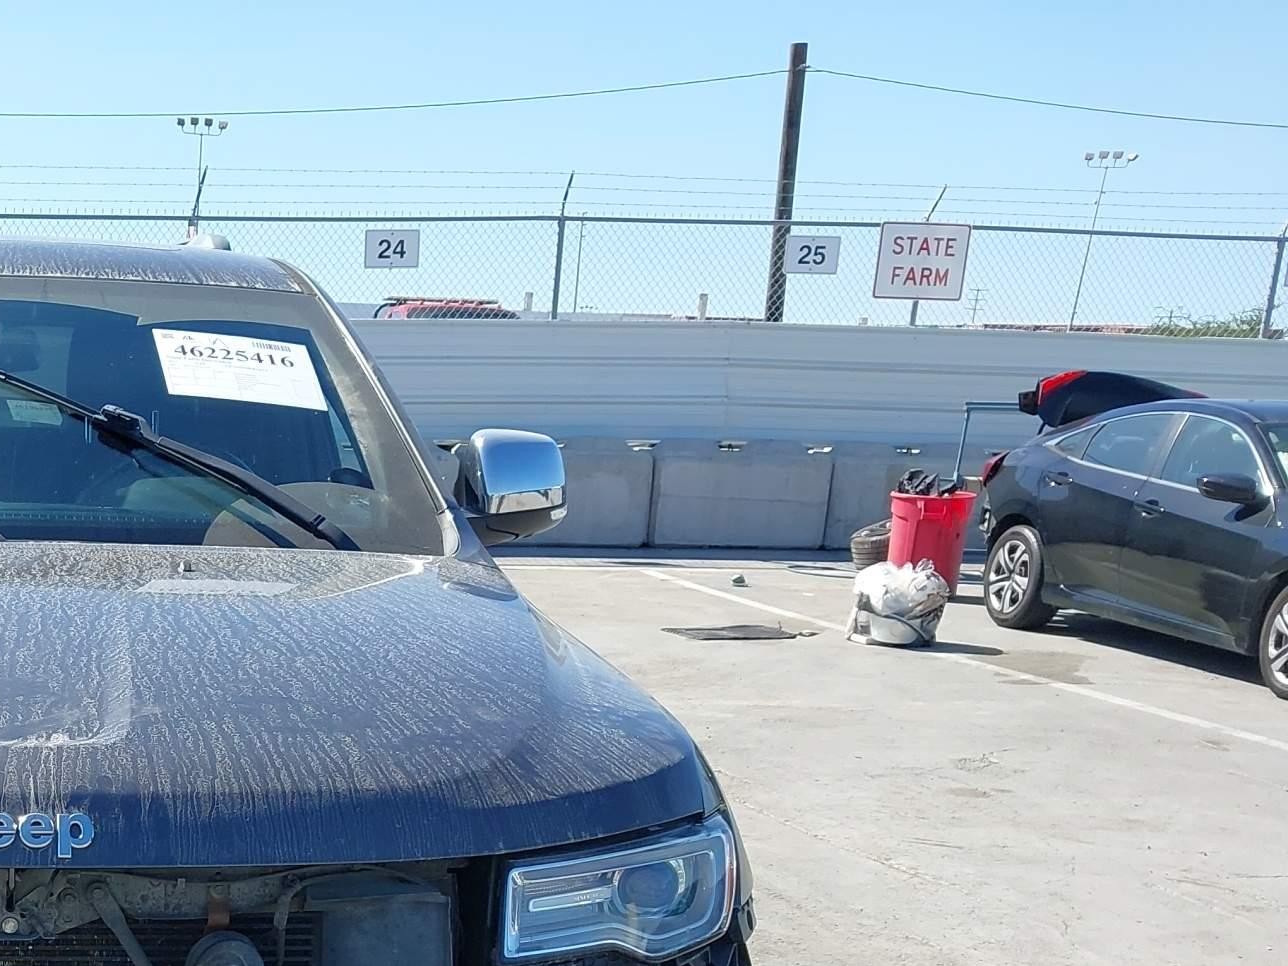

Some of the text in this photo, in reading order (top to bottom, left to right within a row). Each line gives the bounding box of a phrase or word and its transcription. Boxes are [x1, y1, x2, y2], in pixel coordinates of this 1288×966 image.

[377, 239, 407, 259] 24
[797, 244, 827, 265] 25
[892, 236, 957, 257] STATE
[890, 266, 950, 287] FARM
[174, 344, 295, 368] 46225416
